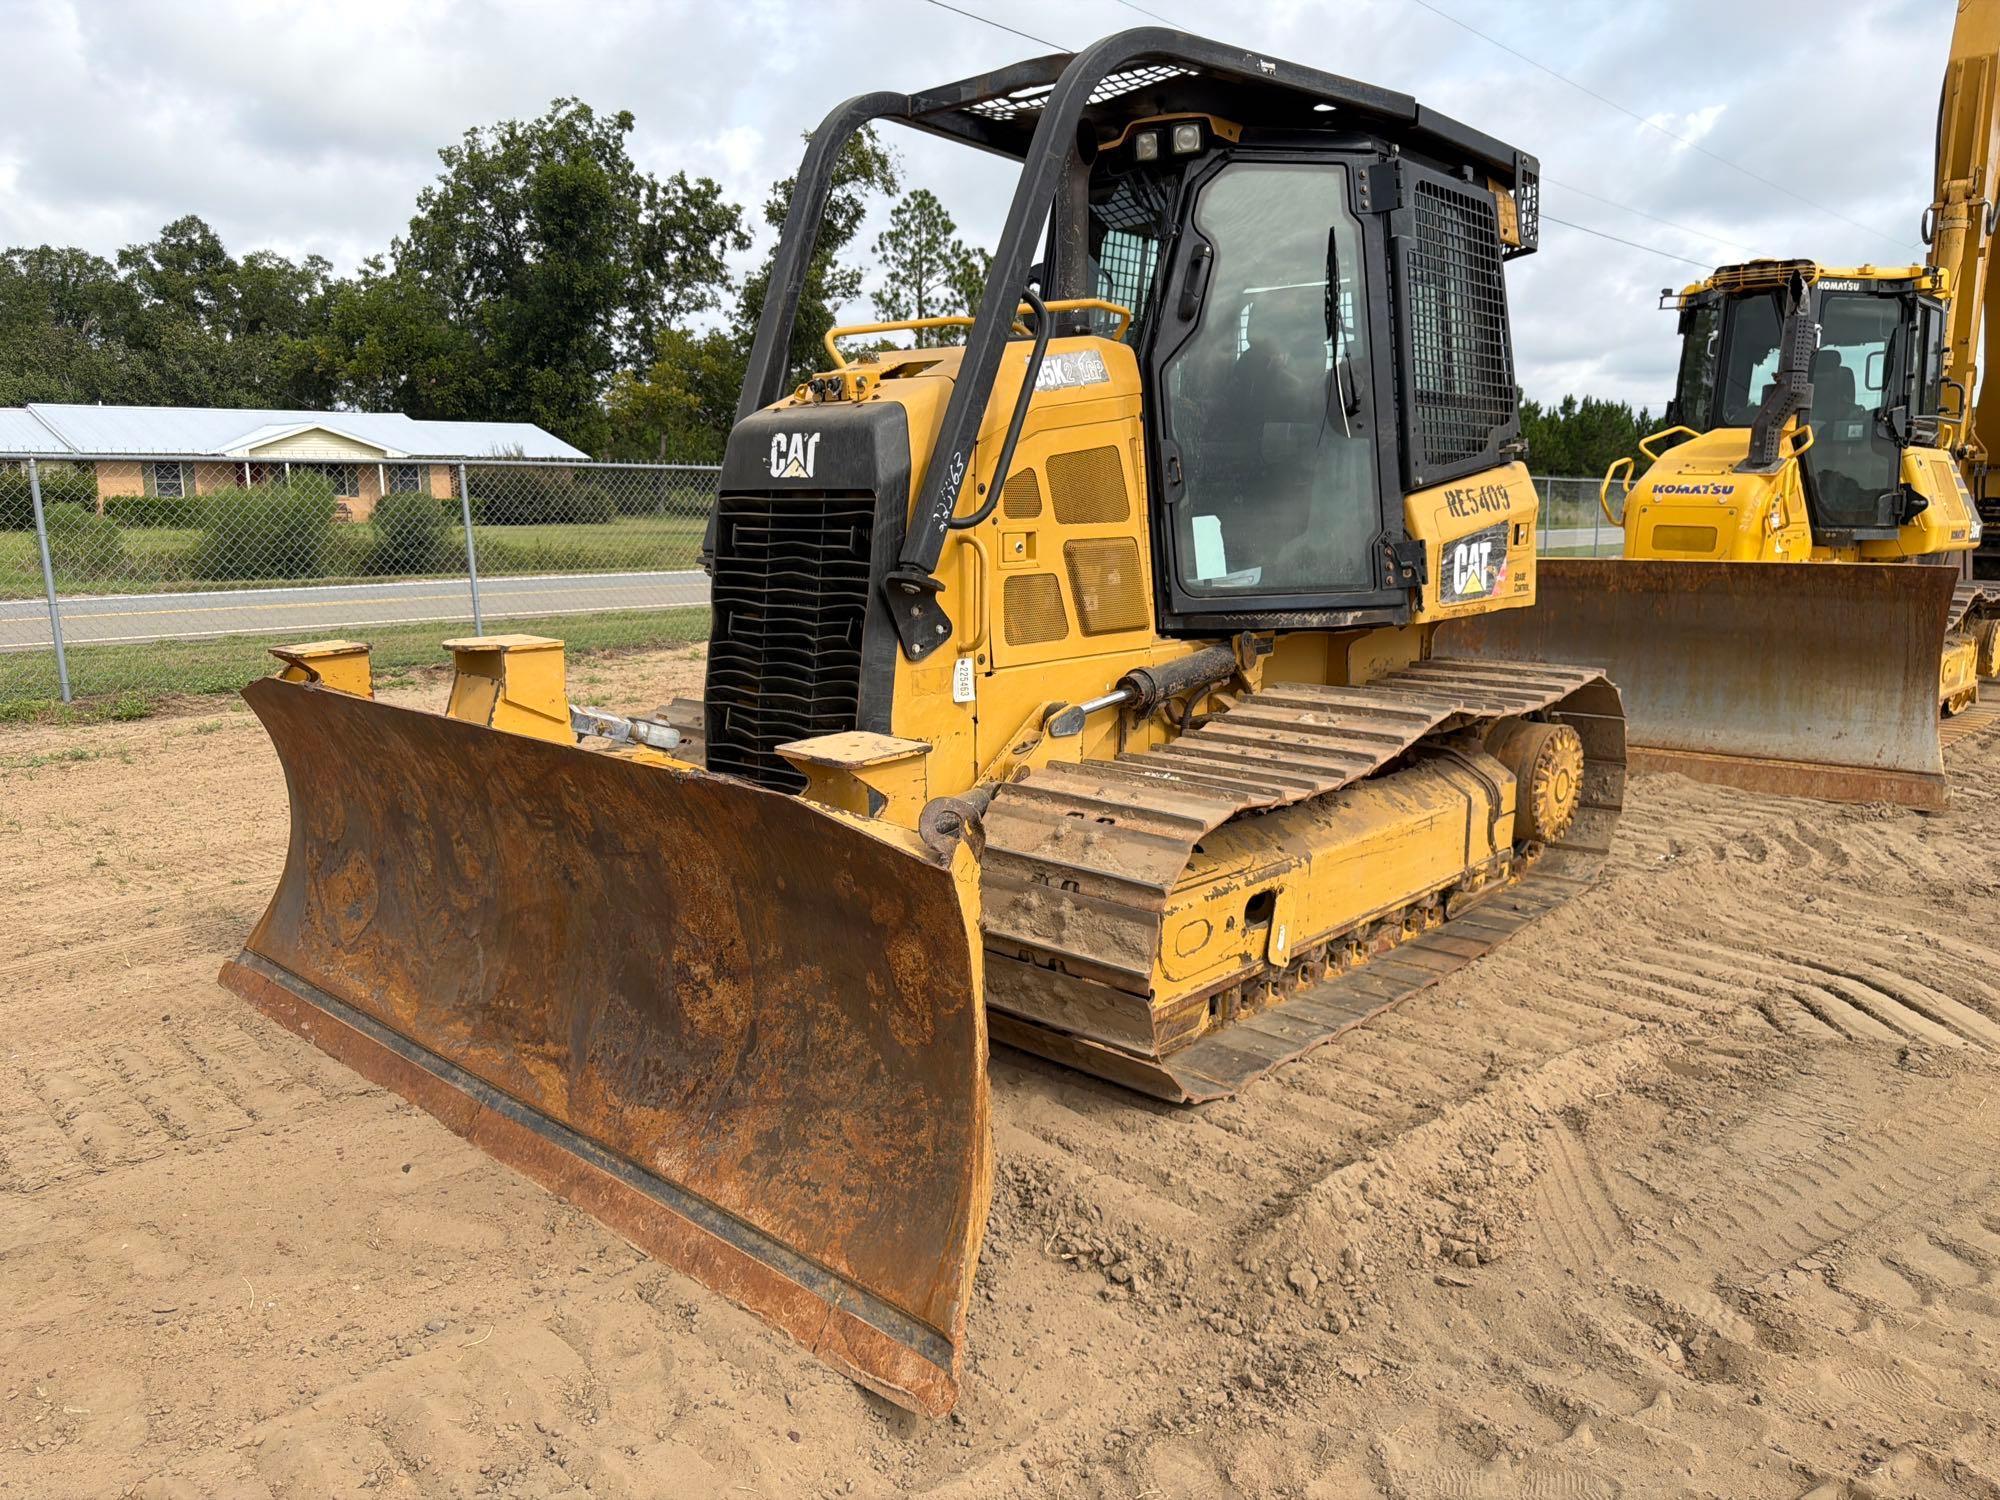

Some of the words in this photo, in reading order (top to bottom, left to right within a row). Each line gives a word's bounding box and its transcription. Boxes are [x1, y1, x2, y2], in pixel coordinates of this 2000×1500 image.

[1817, 281, 1860, 291] KOMATSU
[770, 432, 820, 478] CAT
[1444, 484, 1511, 517] RE5409
[1652, 483, 1734, 495] KOMATSU
[1453, 541, 1492, 594] CAT
[959, 667, 970, 697] 225463
